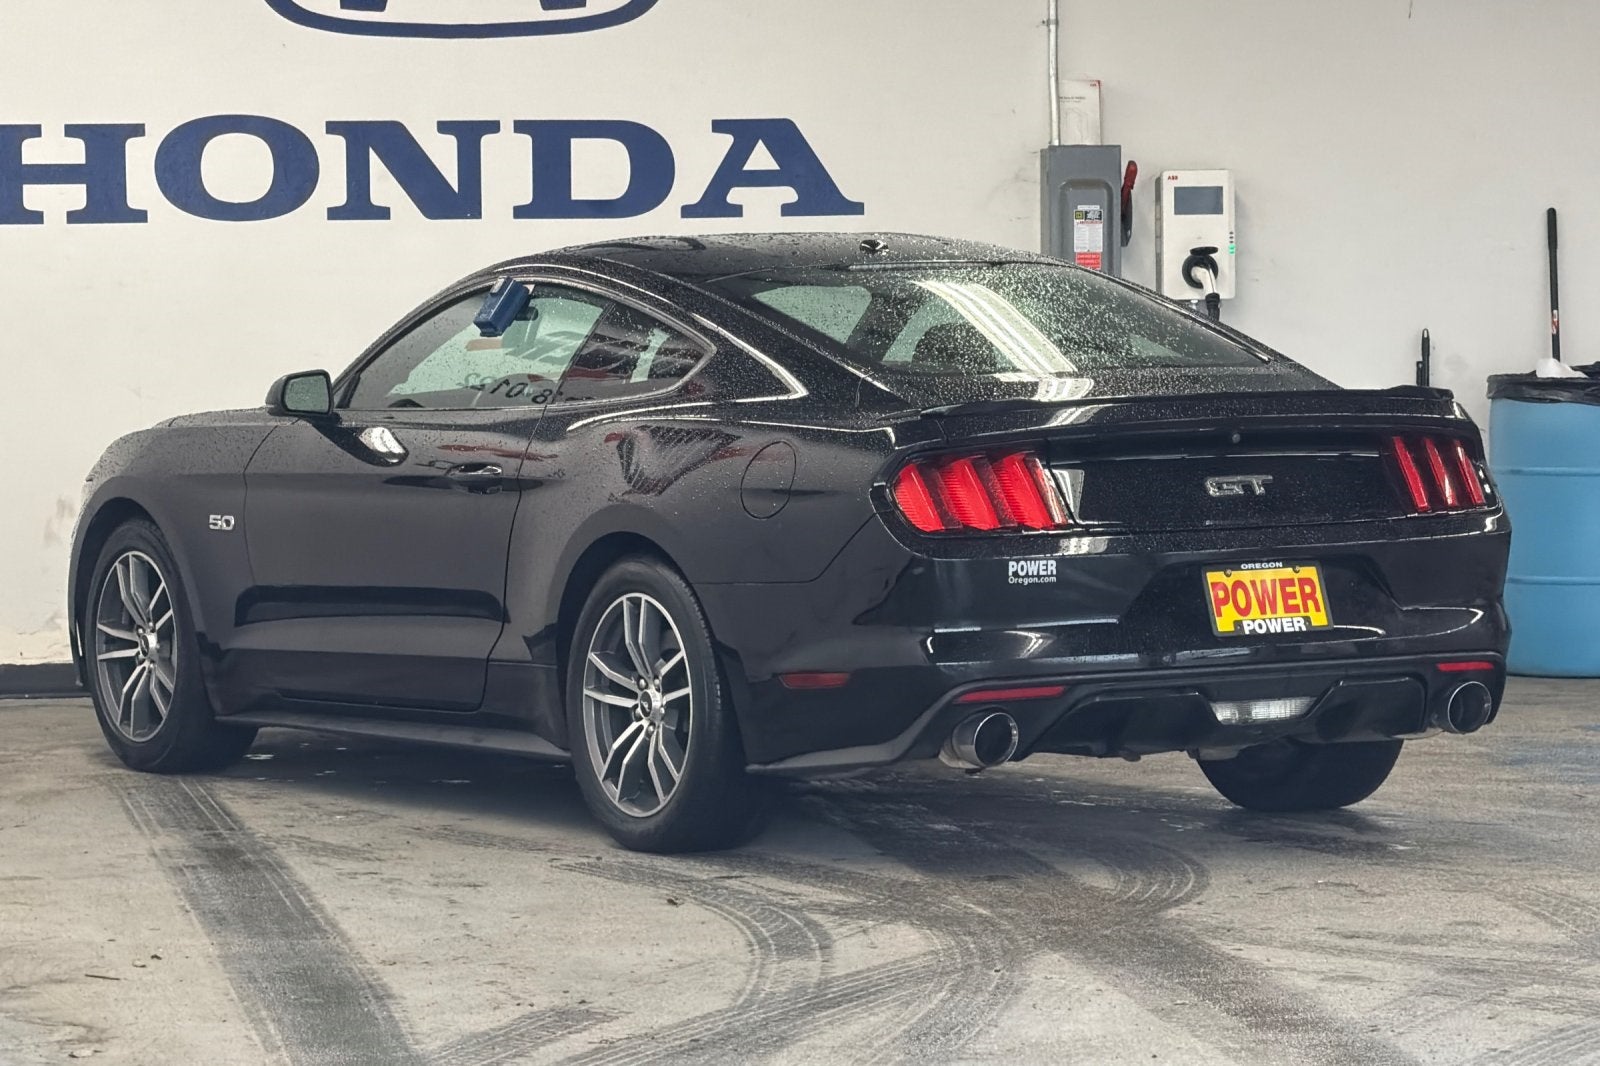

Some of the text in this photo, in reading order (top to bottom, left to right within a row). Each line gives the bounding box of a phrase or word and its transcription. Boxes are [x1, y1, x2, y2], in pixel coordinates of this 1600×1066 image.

[0, 114, 864, 224] HONDA
[1205, 474, 1274, 497] GT
[1008, 560, 1057, 576] POWER
[1008, 576, 1057, 586] Oregon.com
[1210, 577, 1321, 618] POWER
[1242, 617, 1307, 635] POWER
